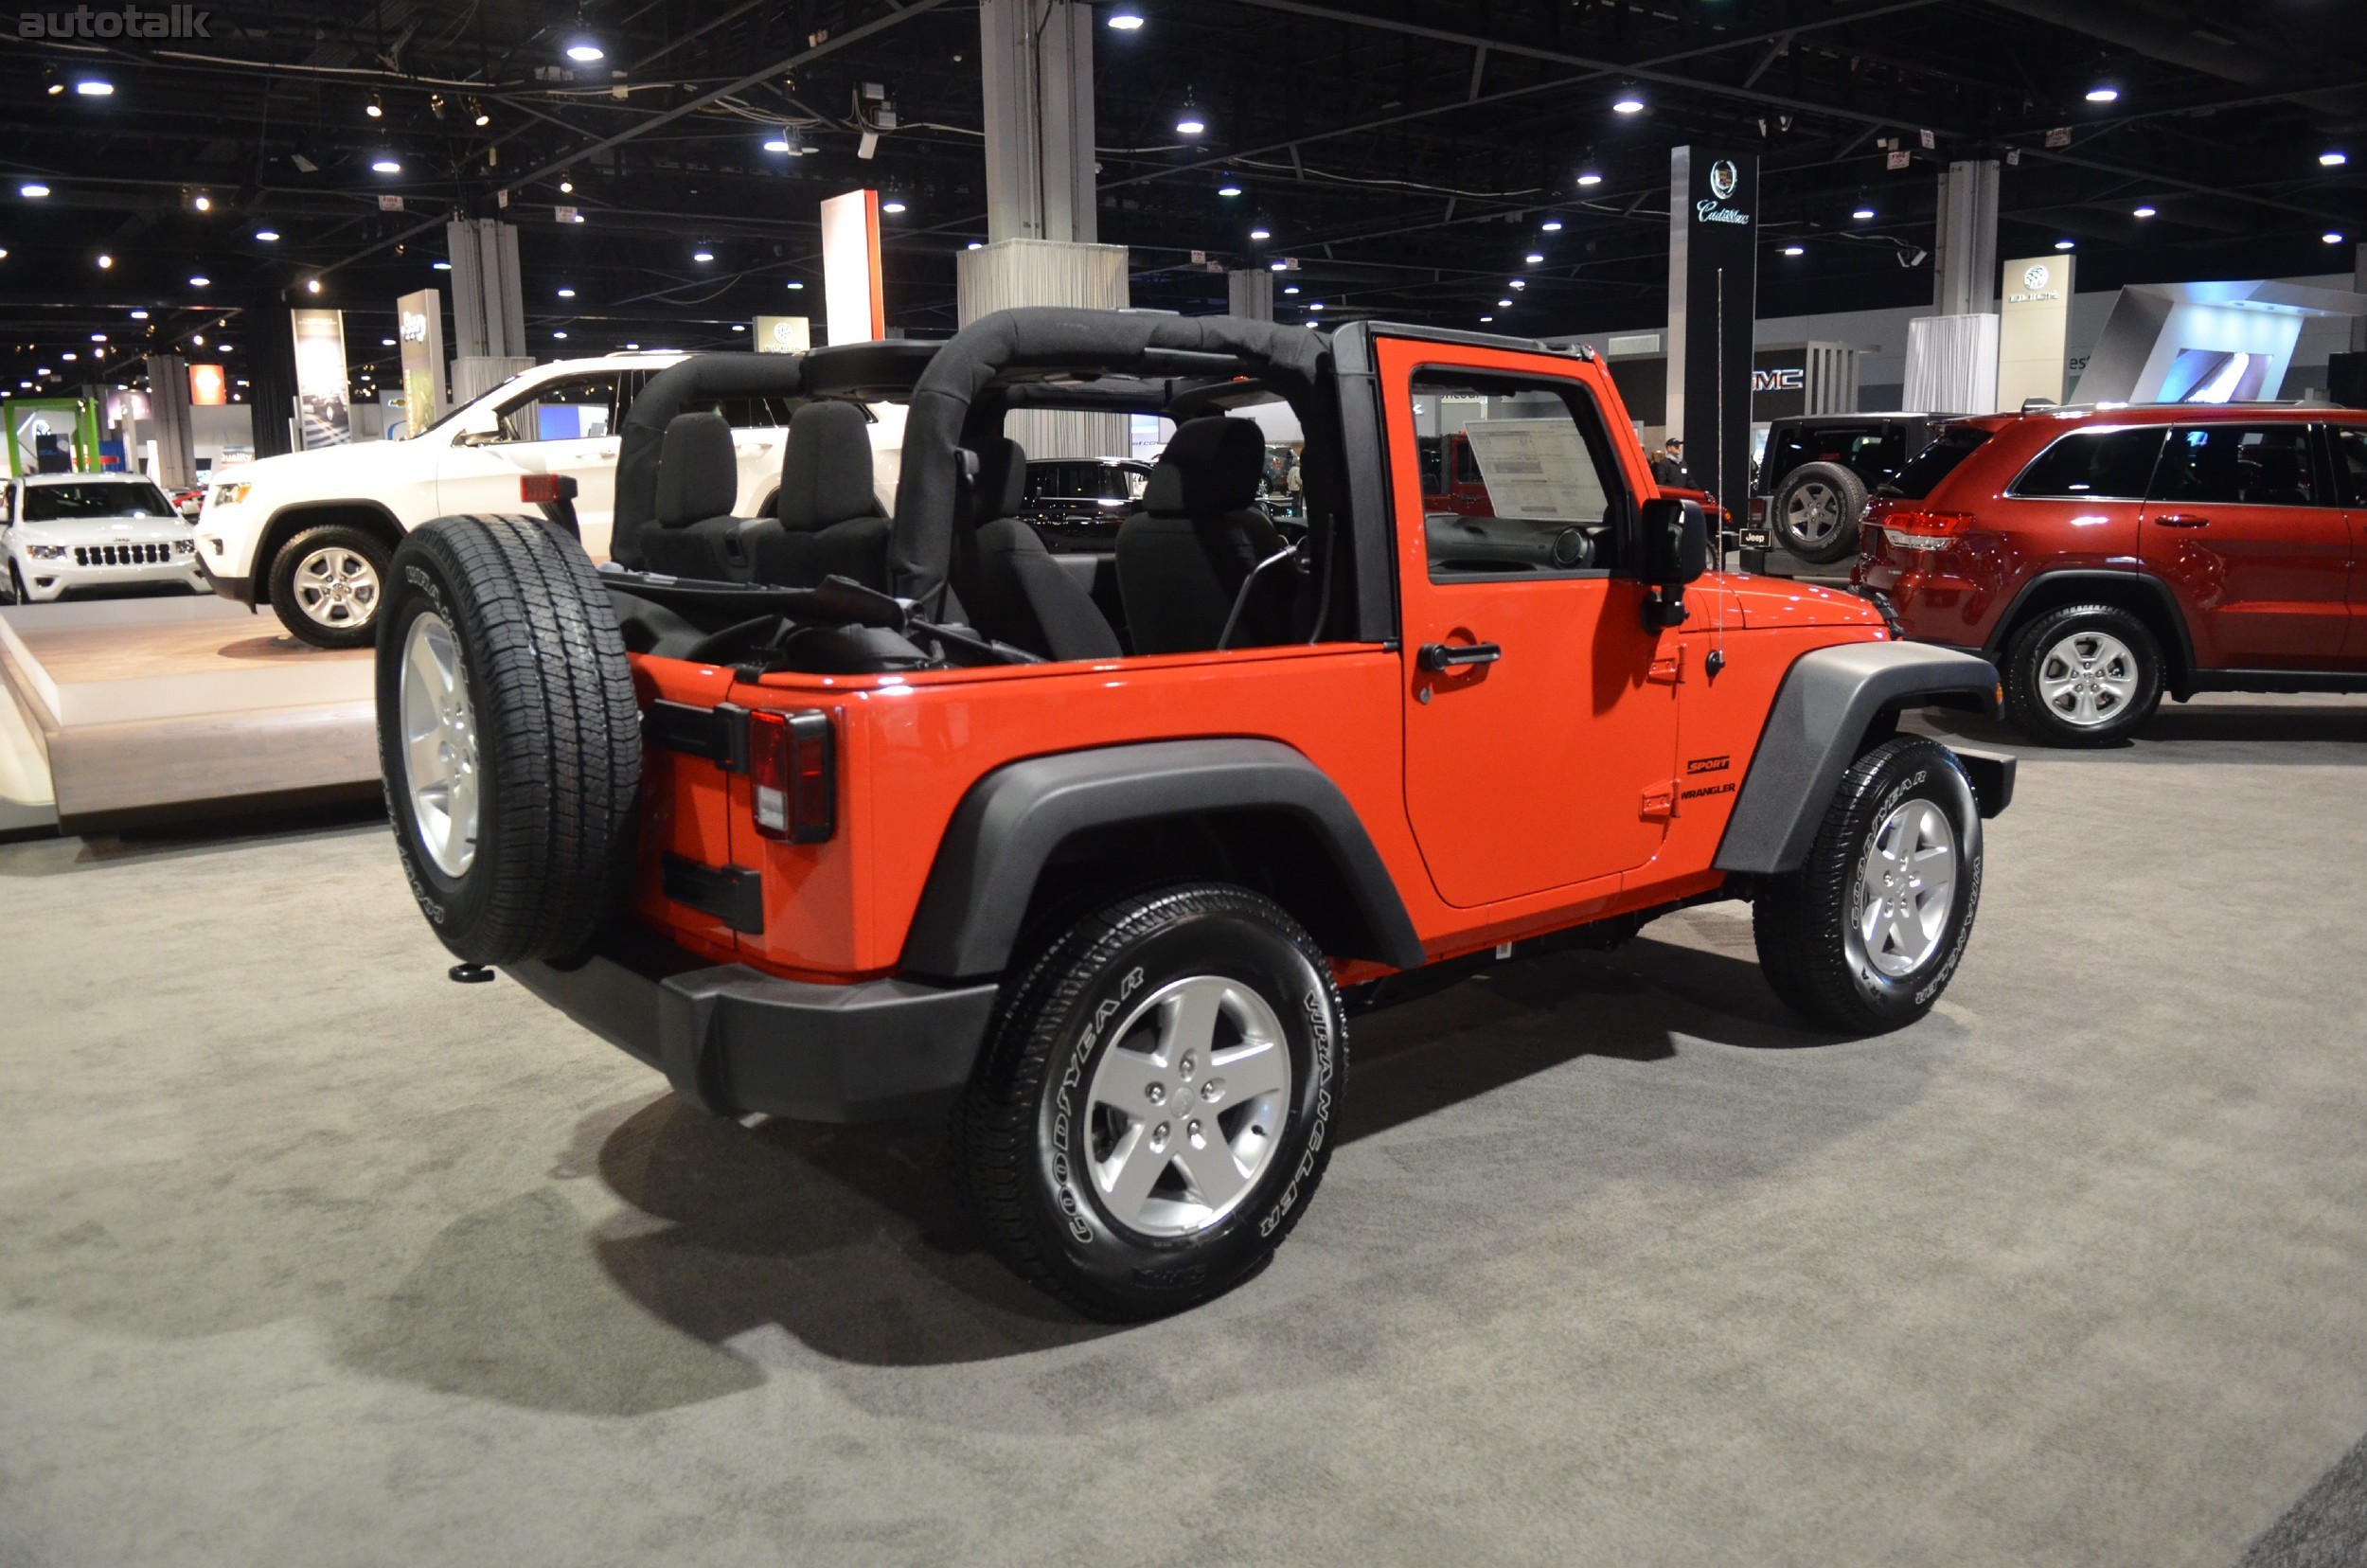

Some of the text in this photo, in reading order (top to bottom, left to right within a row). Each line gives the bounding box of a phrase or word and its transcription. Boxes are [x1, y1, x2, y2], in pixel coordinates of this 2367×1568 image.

[1697, 199, 1750, 224] Cadillac
[1752, 368, 1804, 391] MC
[1745, 532, 1765, 543] Jeep
[1689, 757, 1729, 773] SPORT
[1681, 782, 1735, 800] WRANGLER
[1851, 770, 1928, 930] GOODYEAR
[1914, 856, 1982, 1005] WRANGLER
[1052, 966, 1144, 1242] GOODYEAR
[1260, 989, 1333, 1238] WRANGLER
